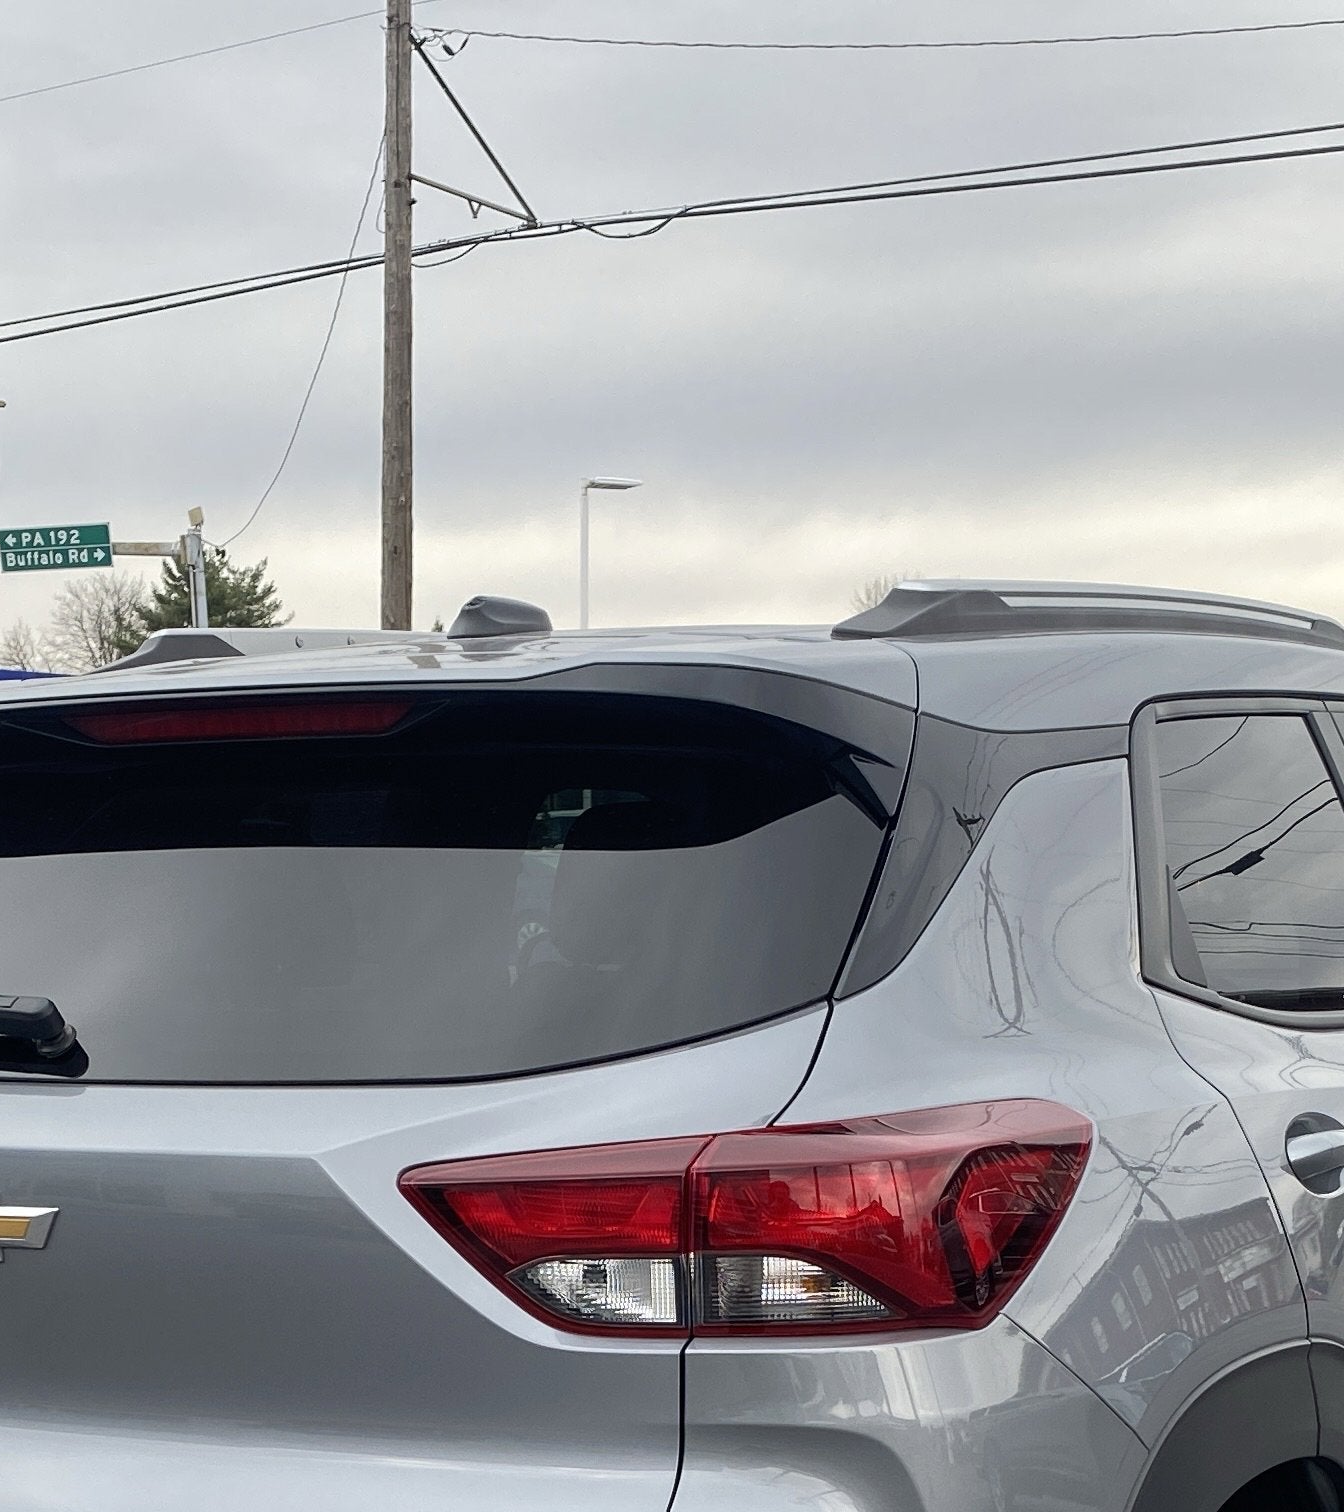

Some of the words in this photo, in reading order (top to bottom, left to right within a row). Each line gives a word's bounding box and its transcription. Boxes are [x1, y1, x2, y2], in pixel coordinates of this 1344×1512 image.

[21, 531, 45, 547] PA
[49, 529, 81, 545] 192
[5, 550, 63, 567] Buffalo
[68, 548, 89, 564] Rd
